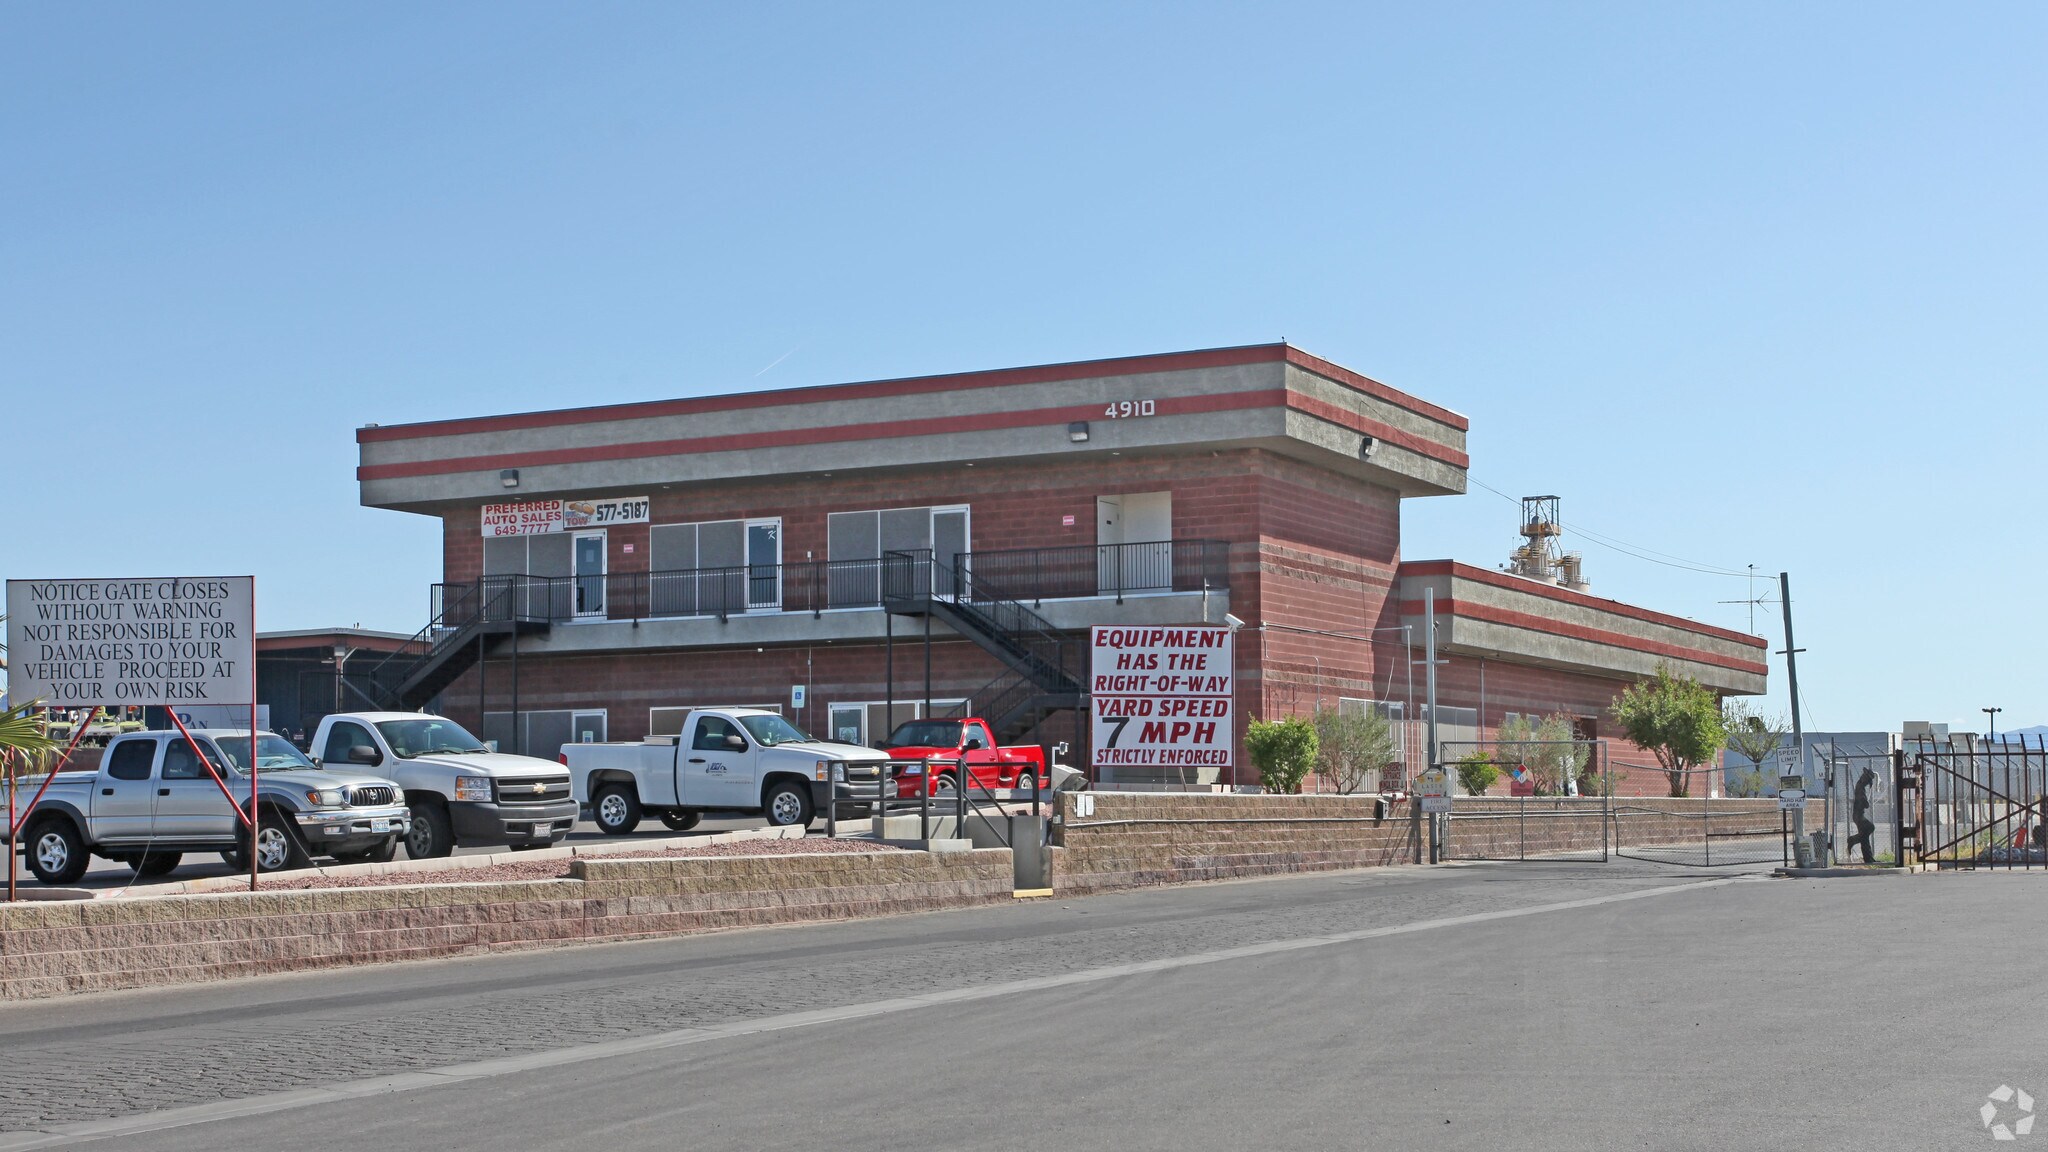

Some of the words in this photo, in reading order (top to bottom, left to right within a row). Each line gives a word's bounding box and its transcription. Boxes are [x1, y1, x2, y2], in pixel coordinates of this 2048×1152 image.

[1105, 400, 1155, 418] 4910
[486, 501, 560, 514] PREFERRED
[597, 501, 648, 521] 577-5187
[483, 514, 517, 526] AUTO
[522, 511, 562, 523] SALES
[565, 517, 588, 526] TOW
[495, 523, 550, 536] 649-7777
[31, 584, 99, 601] NOTICE
[105, 583, 153, 600] GATE
[158, 582, 229, 599] CLOSES
[37, 603, 125, 621] WITHOUT
[133, 601, 222, 619] WARNING
[23, 624, 62, 642] NOT
[68, 622, 192, 641] RESPONSIBLE
[200, 622, 237, 639] FOR
[1095, 629, 1229, 649] EQUIPMENT
[41, 643, 134, 661] DAMAGES
[139, 643, 163, 659] TO
[170, 642, 223, 659] YOUR
[24, 662, 105, 680] VEHICLE
[119, 661, 205, 678] PROCEED
[212, 661, 235, 678] AT
[1116, 653, 1158, 670] HAS
[1168, 653, 1207, 670] THE
[50, 682, 104, 699] YOUR
[115, 682, 160, 699] OWN
[166, 682, 208, 699] RISK
[1094, 675, 1229, 692] RIGHT-OF-WAY
[1097, 699, 1153, 717] YARD
[1158, 699, 1228, 717] SPEED
[1102, 717, 1130, 749] 7
[1138, 721, 1217, 744] MPH
[1096, 749, 1156, 764] STRICTLY
[1159, 749, 1228, 764] ENFORCED
[1785, 763, 1793, 775] 7
